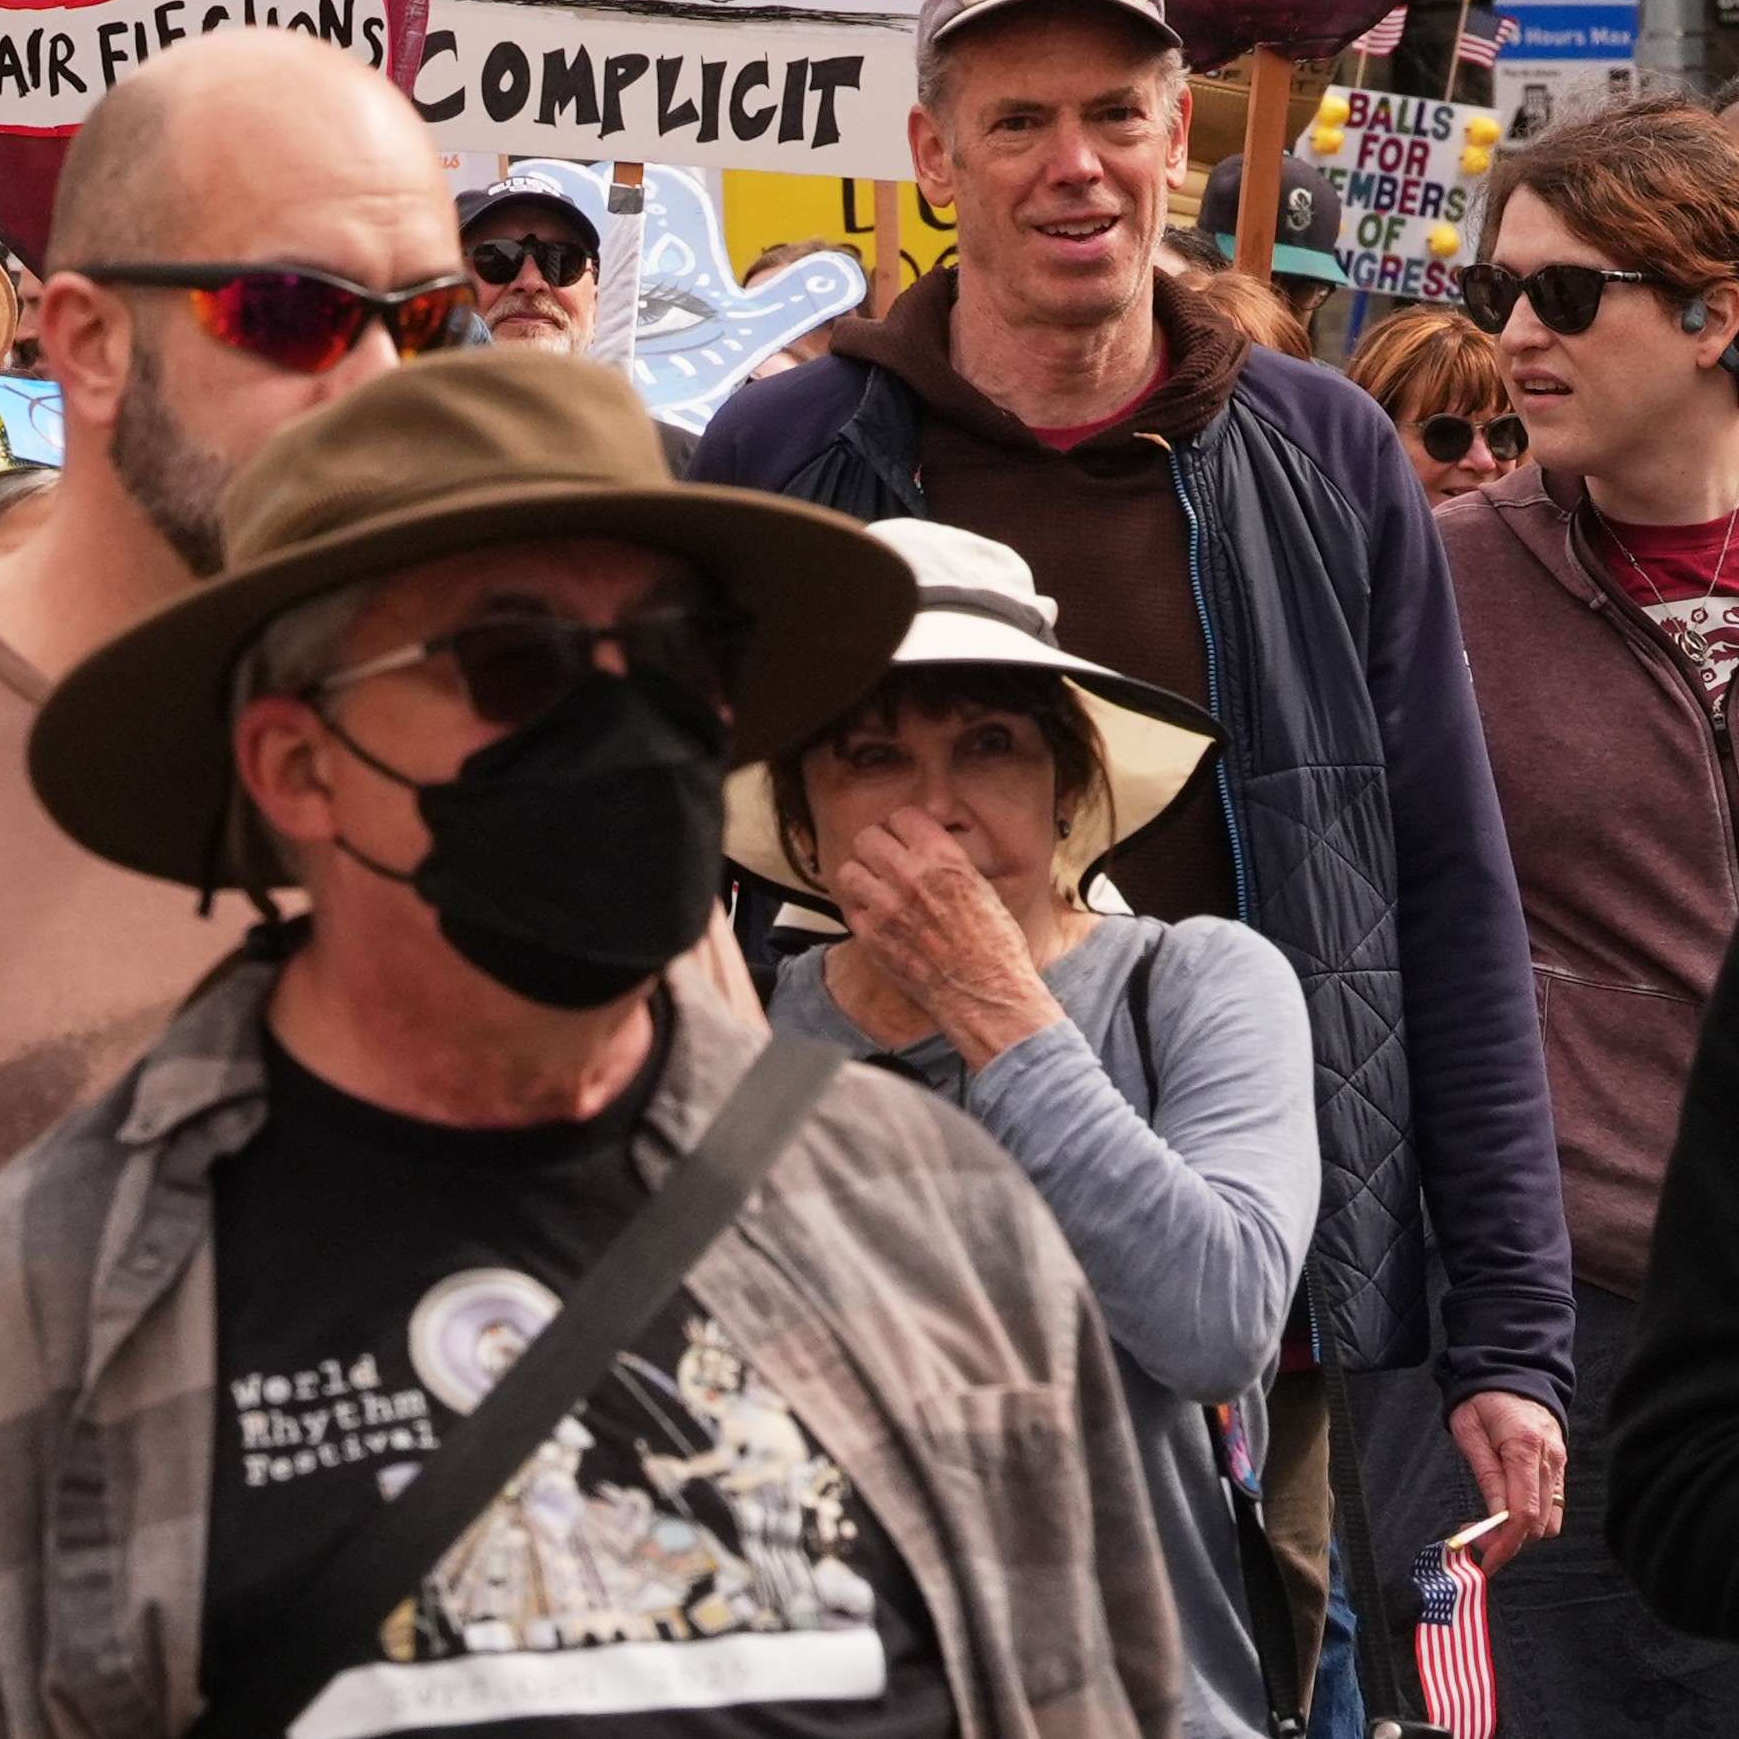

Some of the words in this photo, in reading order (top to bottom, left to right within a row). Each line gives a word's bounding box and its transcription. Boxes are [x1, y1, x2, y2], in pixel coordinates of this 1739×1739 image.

[412, 28, 867, 150] COMPLICIT
[1345, 91, 1455, 142] BALLS
[1356, 132, 1431, 178] FOR
[1316, 165, 1468, 223] EMBERS
[1356, 213, 1407, 252] OF
[231, 1353, 380, 1409] World
[234, 1393, 428, 1452] Rhythm
[242, 1420, 441, 1488] Festival
